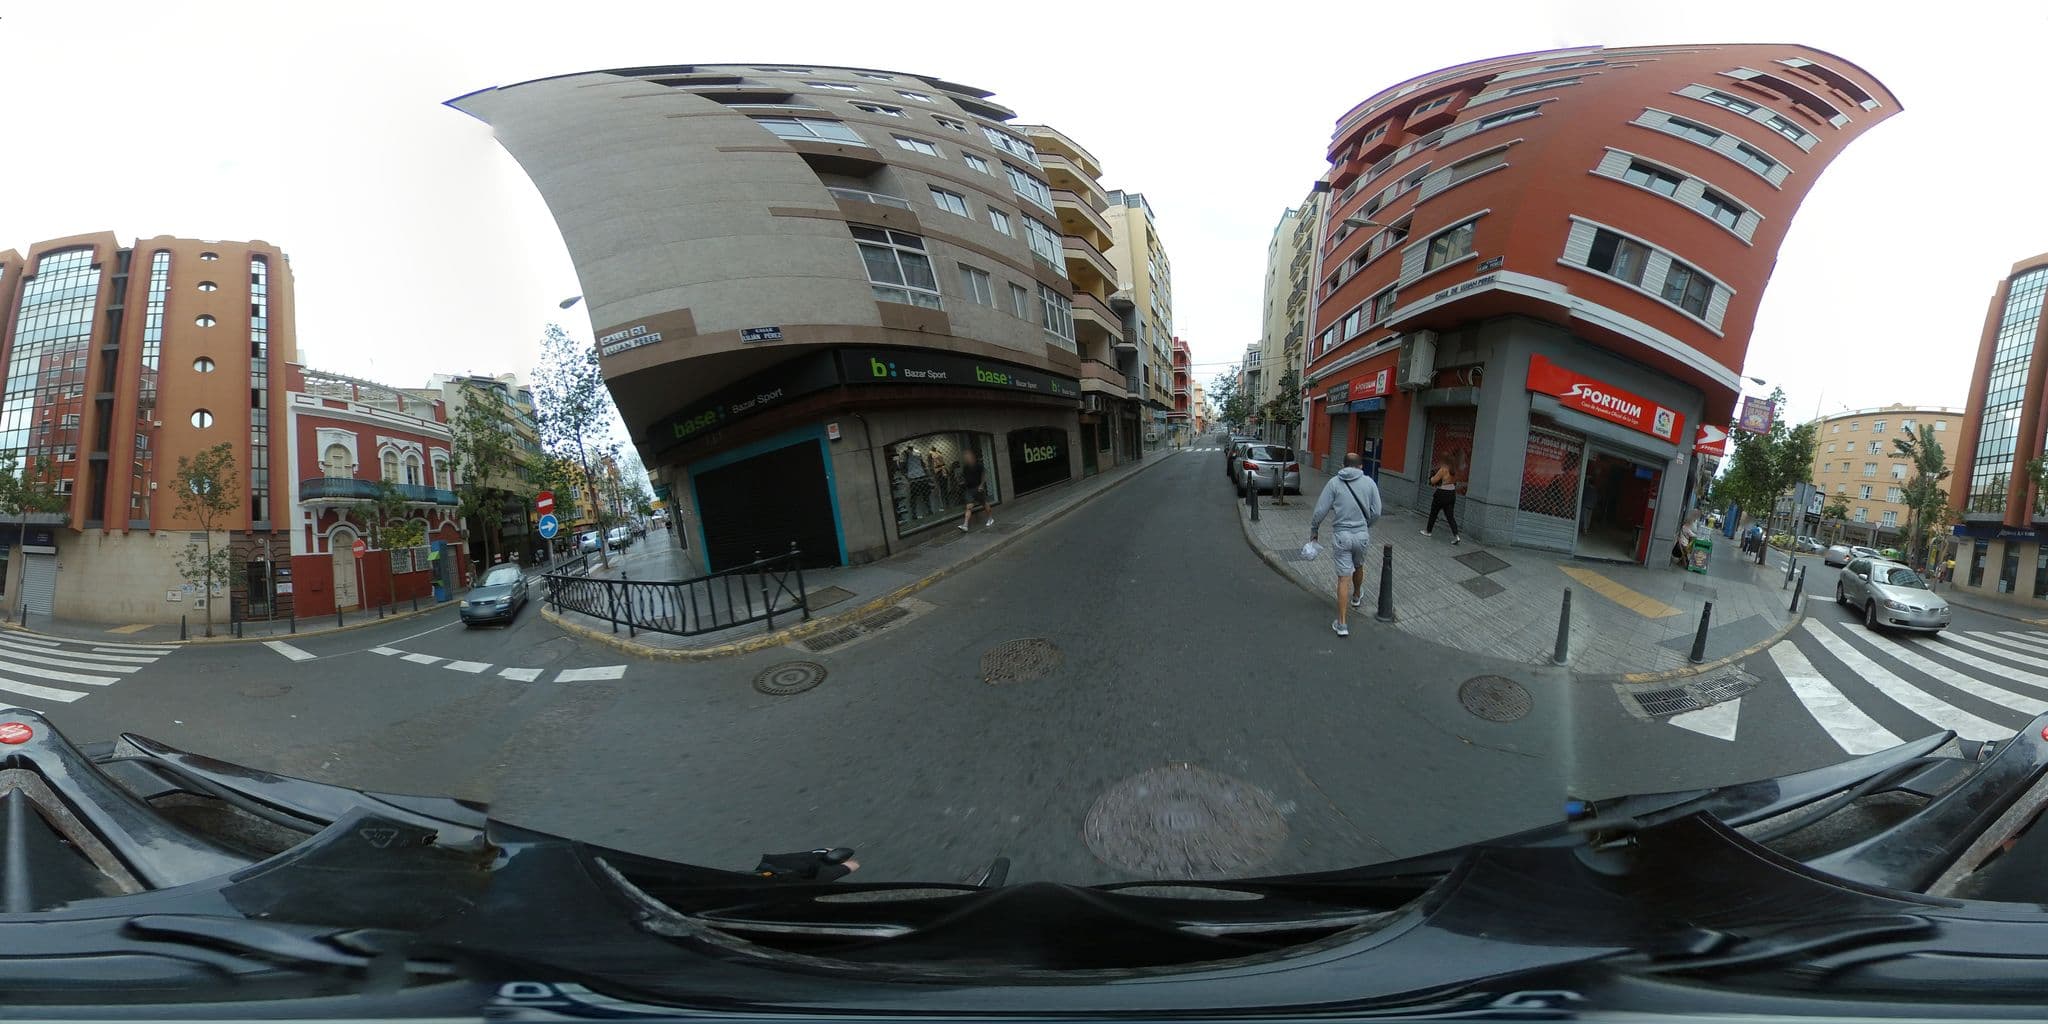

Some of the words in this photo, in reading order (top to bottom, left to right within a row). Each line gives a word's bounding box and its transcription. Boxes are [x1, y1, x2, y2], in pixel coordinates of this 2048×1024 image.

[904, 368, 926, 378] Bazar
[927, 369, 947, 380] Sport
[732, 399, 756, 414] Bazar
[757, 388, 783, 404] Sport
[1560, 383, 1641, 418] SPORTIUM
